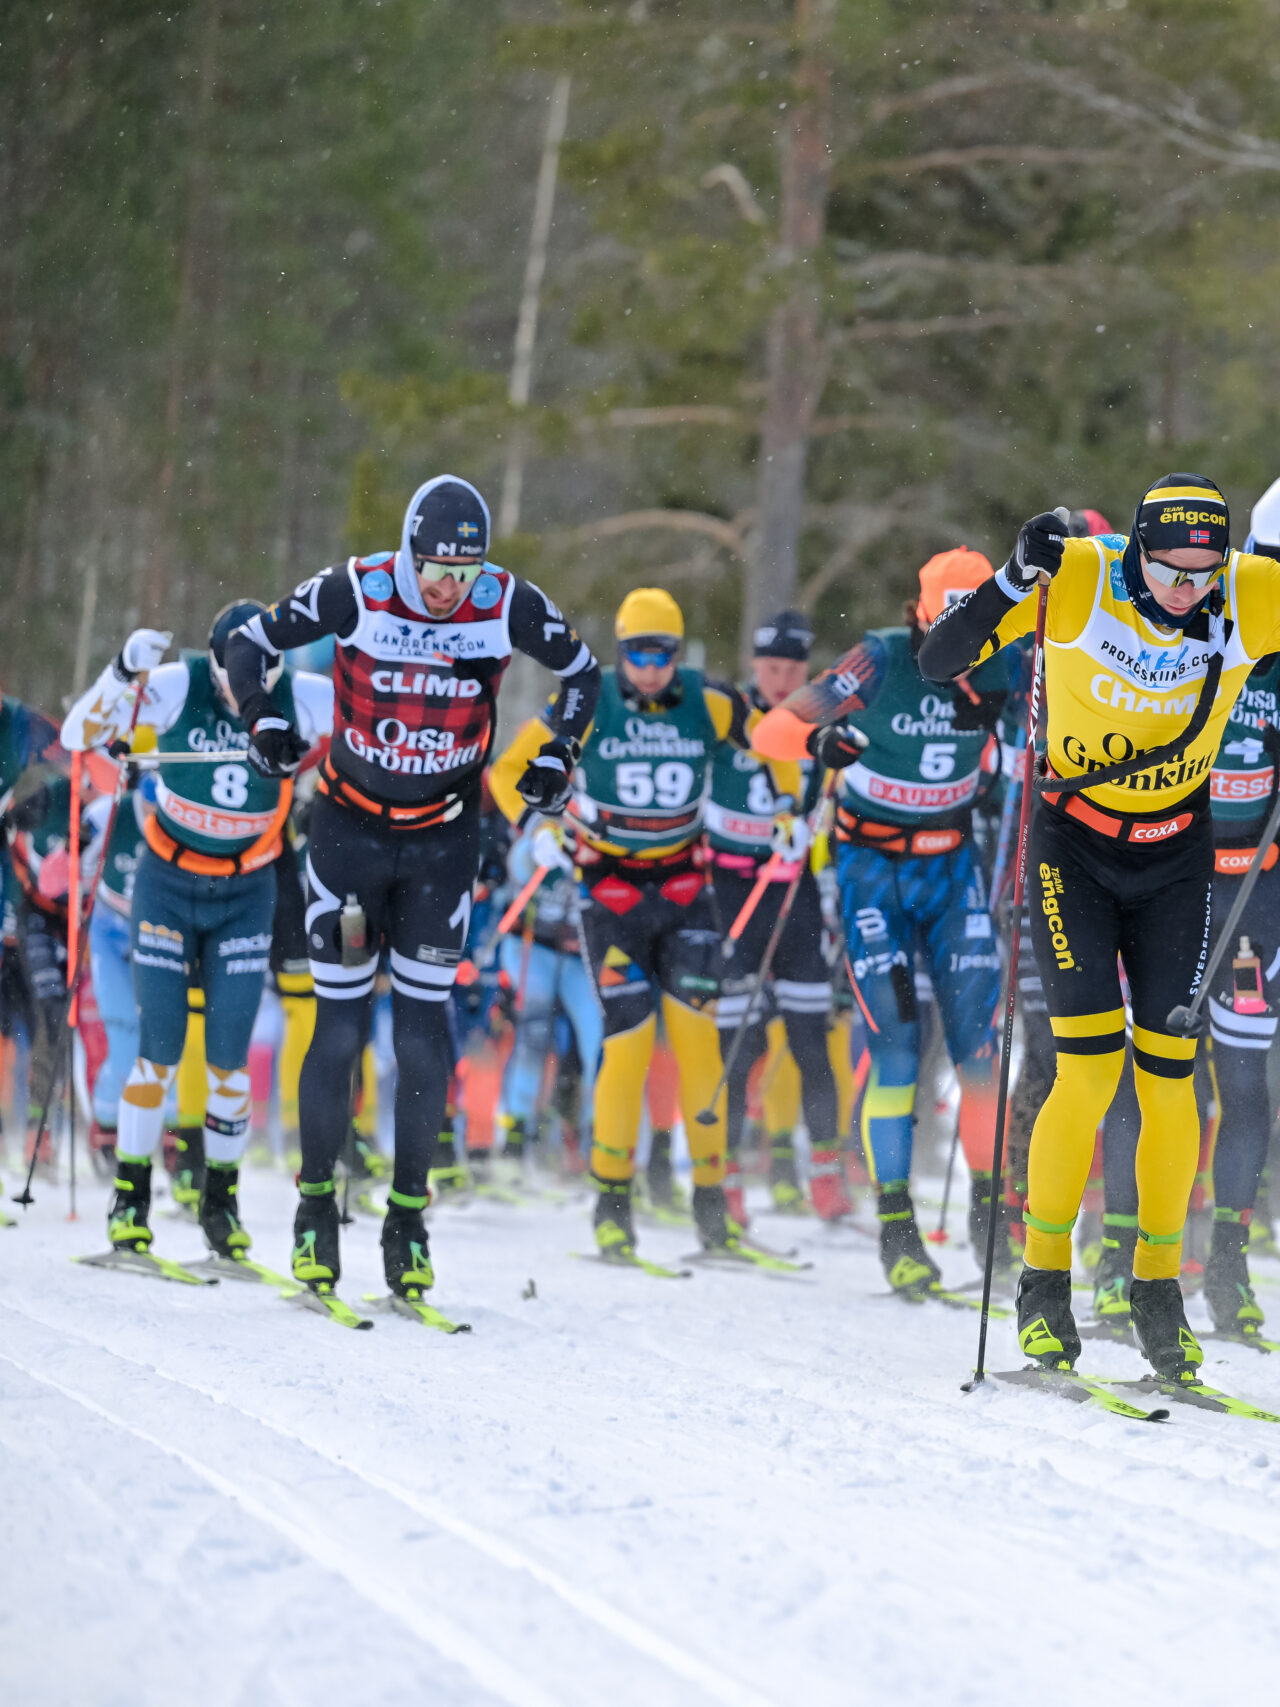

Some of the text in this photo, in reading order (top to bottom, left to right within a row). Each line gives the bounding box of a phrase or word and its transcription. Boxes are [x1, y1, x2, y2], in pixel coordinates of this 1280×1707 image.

[1160, 509, 1227, 527] engcon
[1100, 639, 1209, 682] PROXCSKIING.CO
[376, 717, 455, 751] Orsa
[625, 716, 680, 740] Orsa
[344, 727, 480, 775] Grönklitt
[598, 736, 705, 760] Grönklitt
[918, 742, 957, 781] 5
[1223, 736, 1264, 764] 4
[210, 763, 249, 809] 8
[615, 761, 695, 808] 59
[1134, 821, 1179, 839] COXA
[1050, 866, 1064, 894] TEAM
[1039, 862, 1075, 970] engcon
